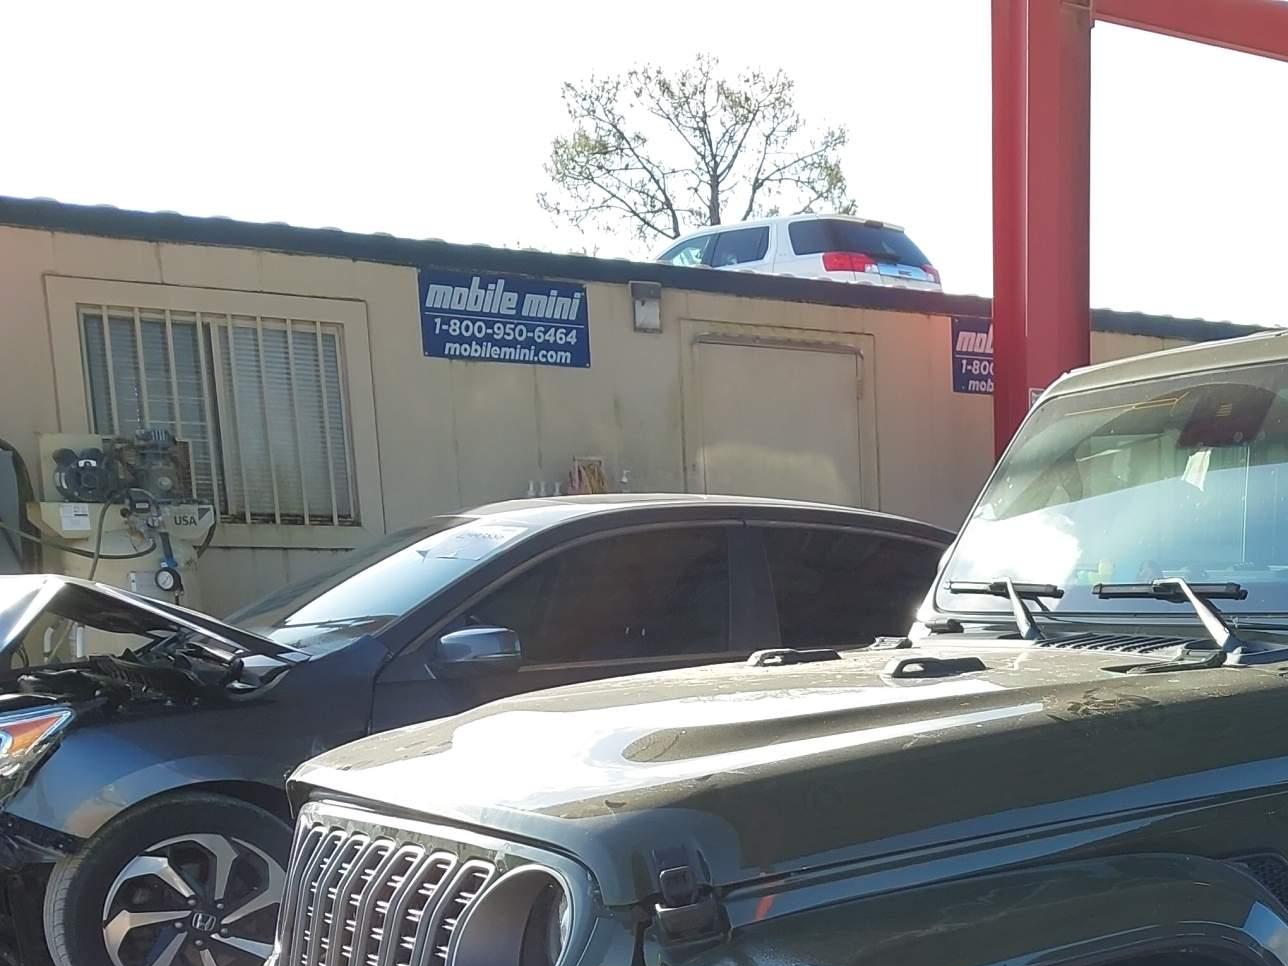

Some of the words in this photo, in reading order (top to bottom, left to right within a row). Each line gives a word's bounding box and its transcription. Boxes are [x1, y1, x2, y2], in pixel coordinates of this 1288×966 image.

[425, 276, 518, 315] mobile
[522, 289, 582, 321] mini
[434, 317, 577, 345] 1-800-950-6464
[444, 341, 571, 364] mobilemini.com
[174, 515, 198, 526] USA
